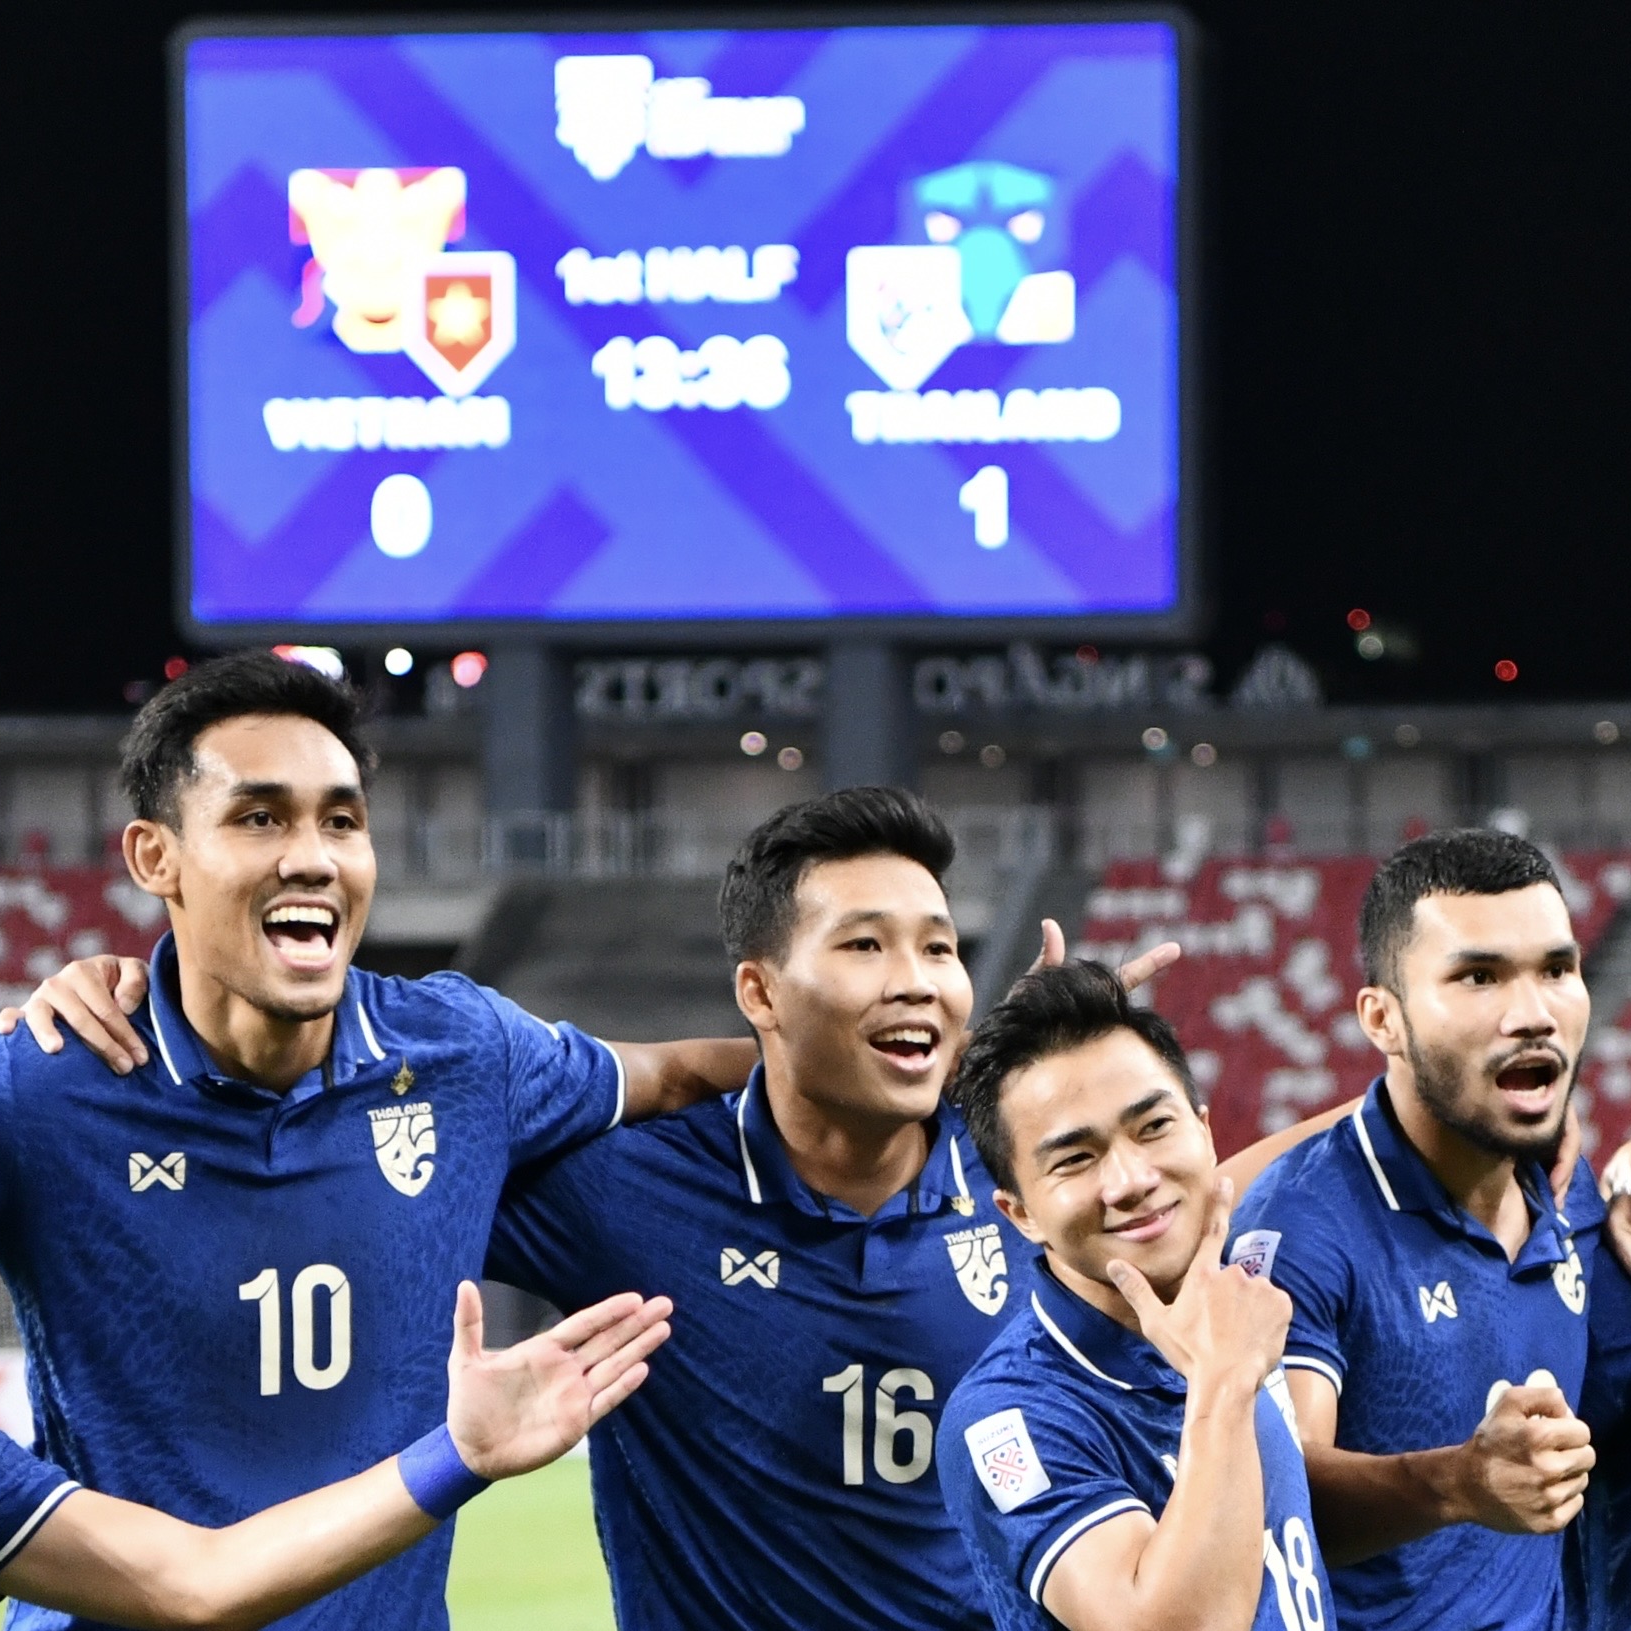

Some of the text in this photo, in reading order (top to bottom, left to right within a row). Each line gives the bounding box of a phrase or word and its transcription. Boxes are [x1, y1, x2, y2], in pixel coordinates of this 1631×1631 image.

[645, 244, 801, 304] HALF
[370, 473, 433, 558] 0
[959, 464, 1009, 549] 1
[367, 1102, 432, 1120] THAILAND
[943, 1224, 999, 1245] THAILAND
[239, 1263, 351, 1397] 10
[822, 1364, 935, 1487] 16
